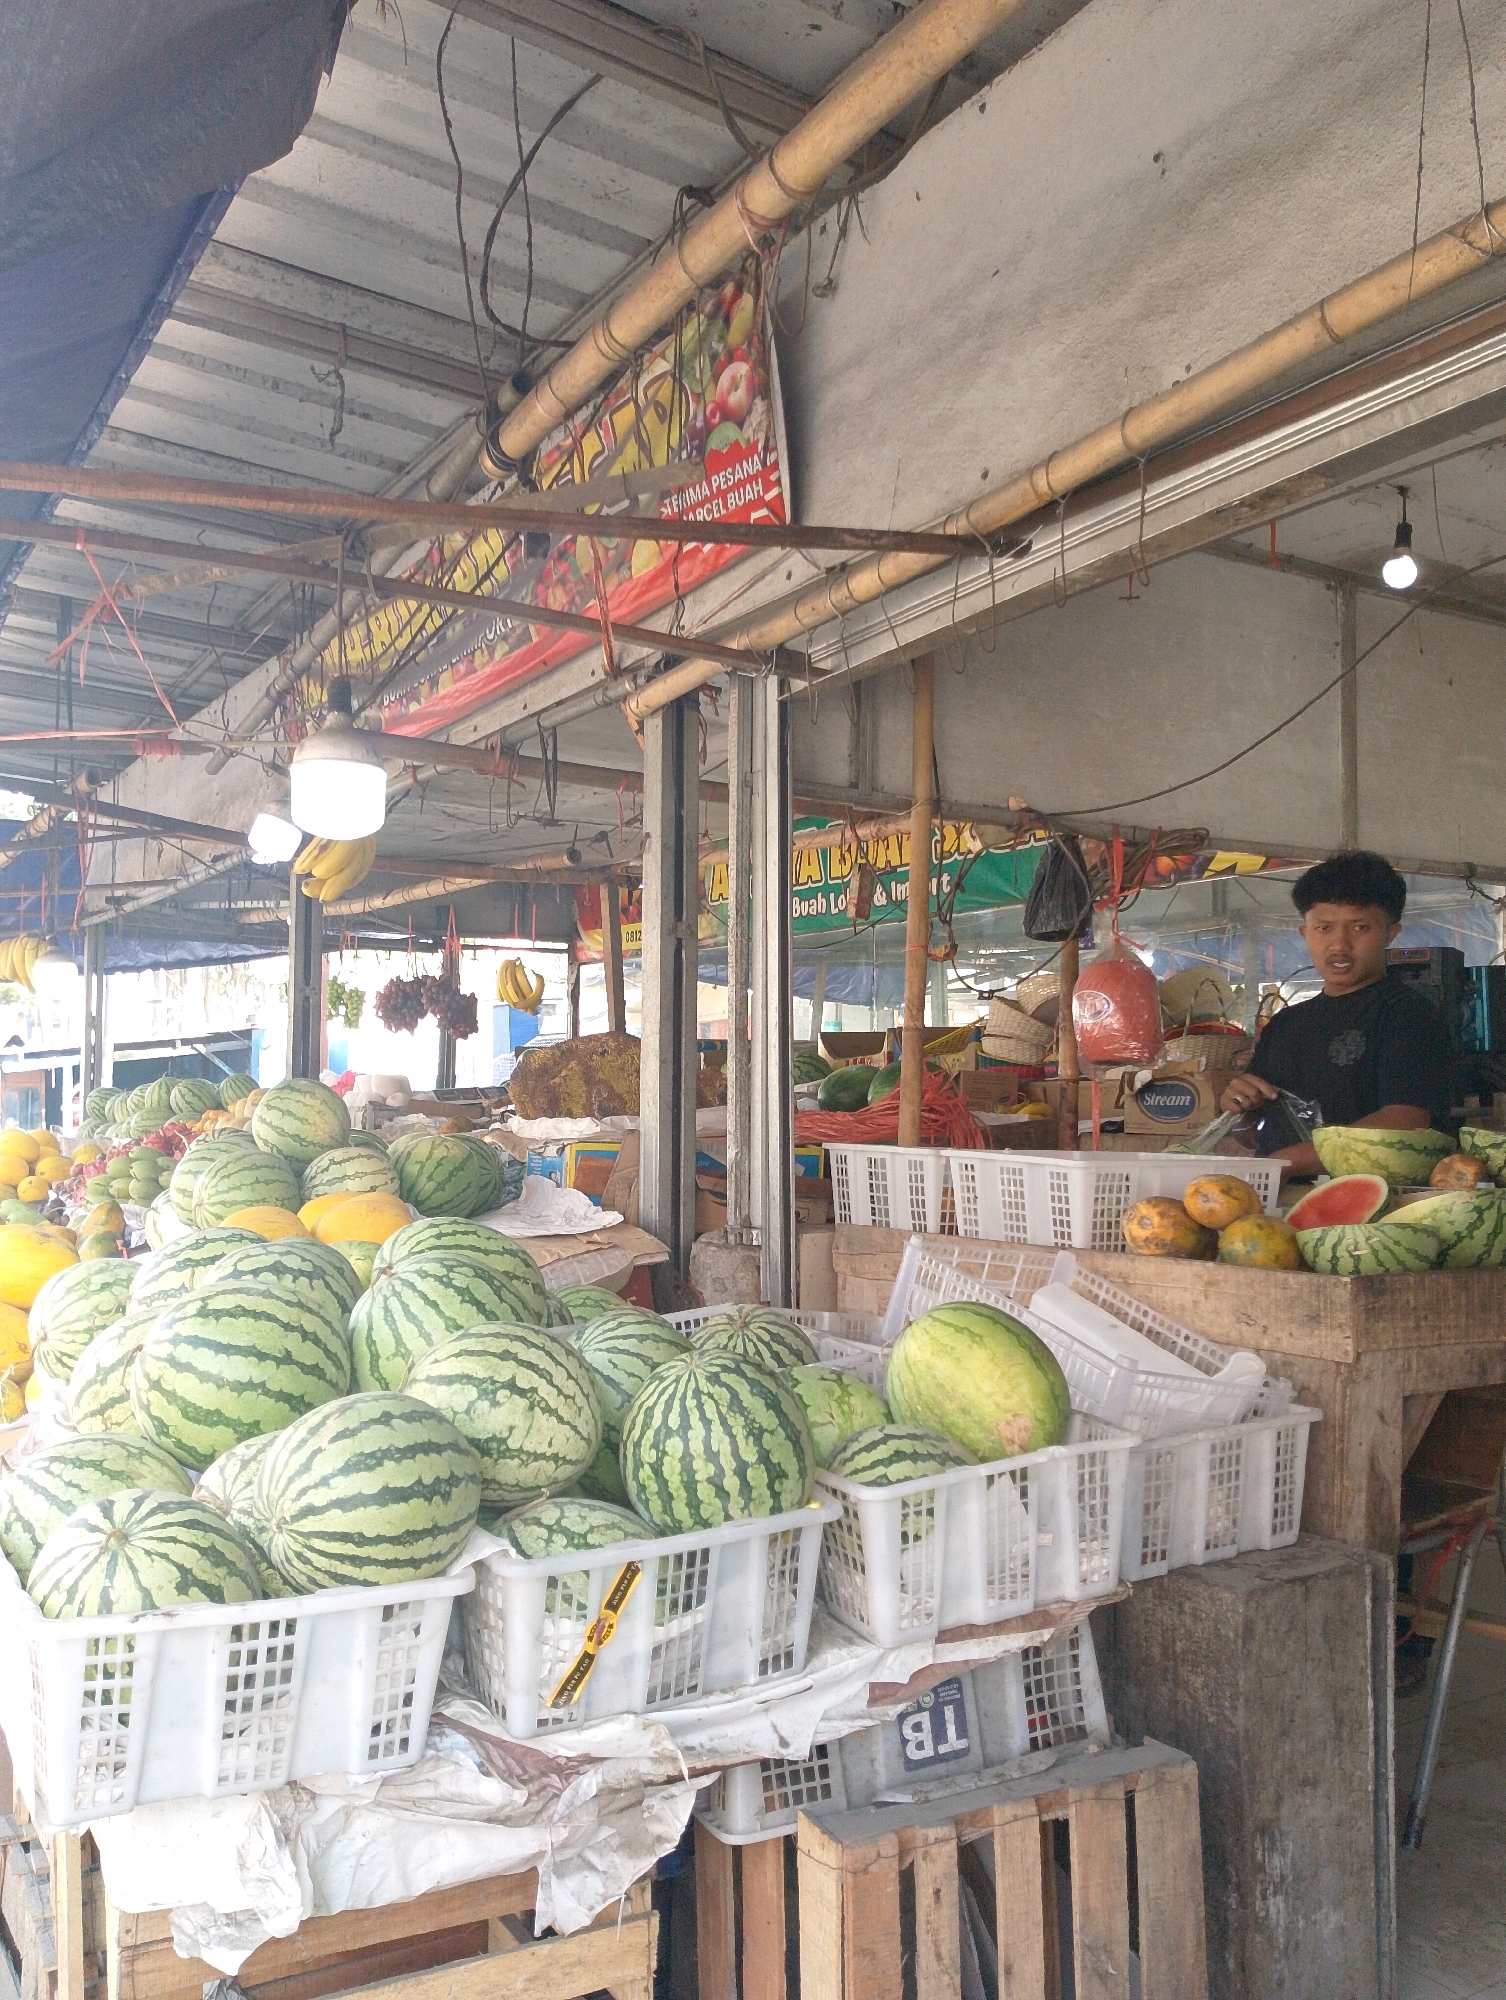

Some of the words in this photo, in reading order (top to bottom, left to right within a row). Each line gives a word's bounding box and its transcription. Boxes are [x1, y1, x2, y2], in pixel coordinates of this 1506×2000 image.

[663, 480, 710, 516] TERIMA
[682, 497, 726, 522] ARCEL
[727, 477, 763, 511] BUAH
[792, 891, 827, 918] Buah
[873, 882, 887, 907] &
[890, 872, 951, 902] Imrt
[1143, 1092, 1192, 1106] Stream
[902, 1704, 969, 1760] TB
